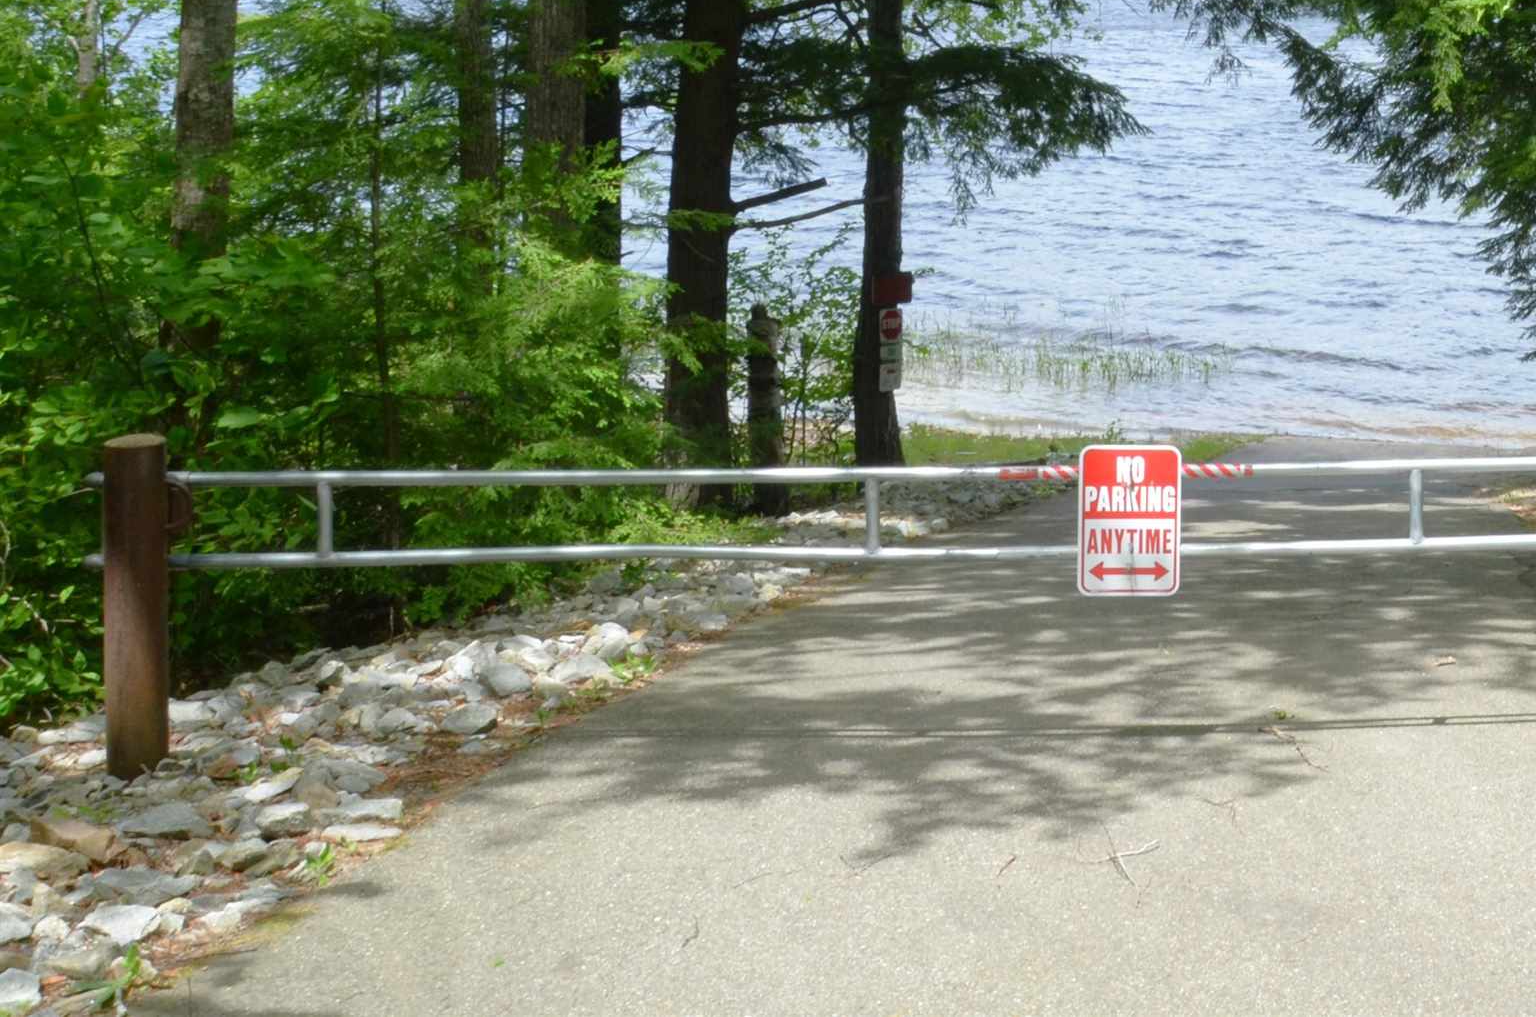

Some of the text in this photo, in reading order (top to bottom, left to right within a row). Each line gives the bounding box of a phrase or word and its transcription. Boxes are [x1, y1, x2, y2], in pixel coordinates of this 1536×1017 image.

[1116, 456, 1146, 483] NO
[1084, 485, 1176, 512] PARKING
[1087, 529, 1172, 554] ANYTIME
